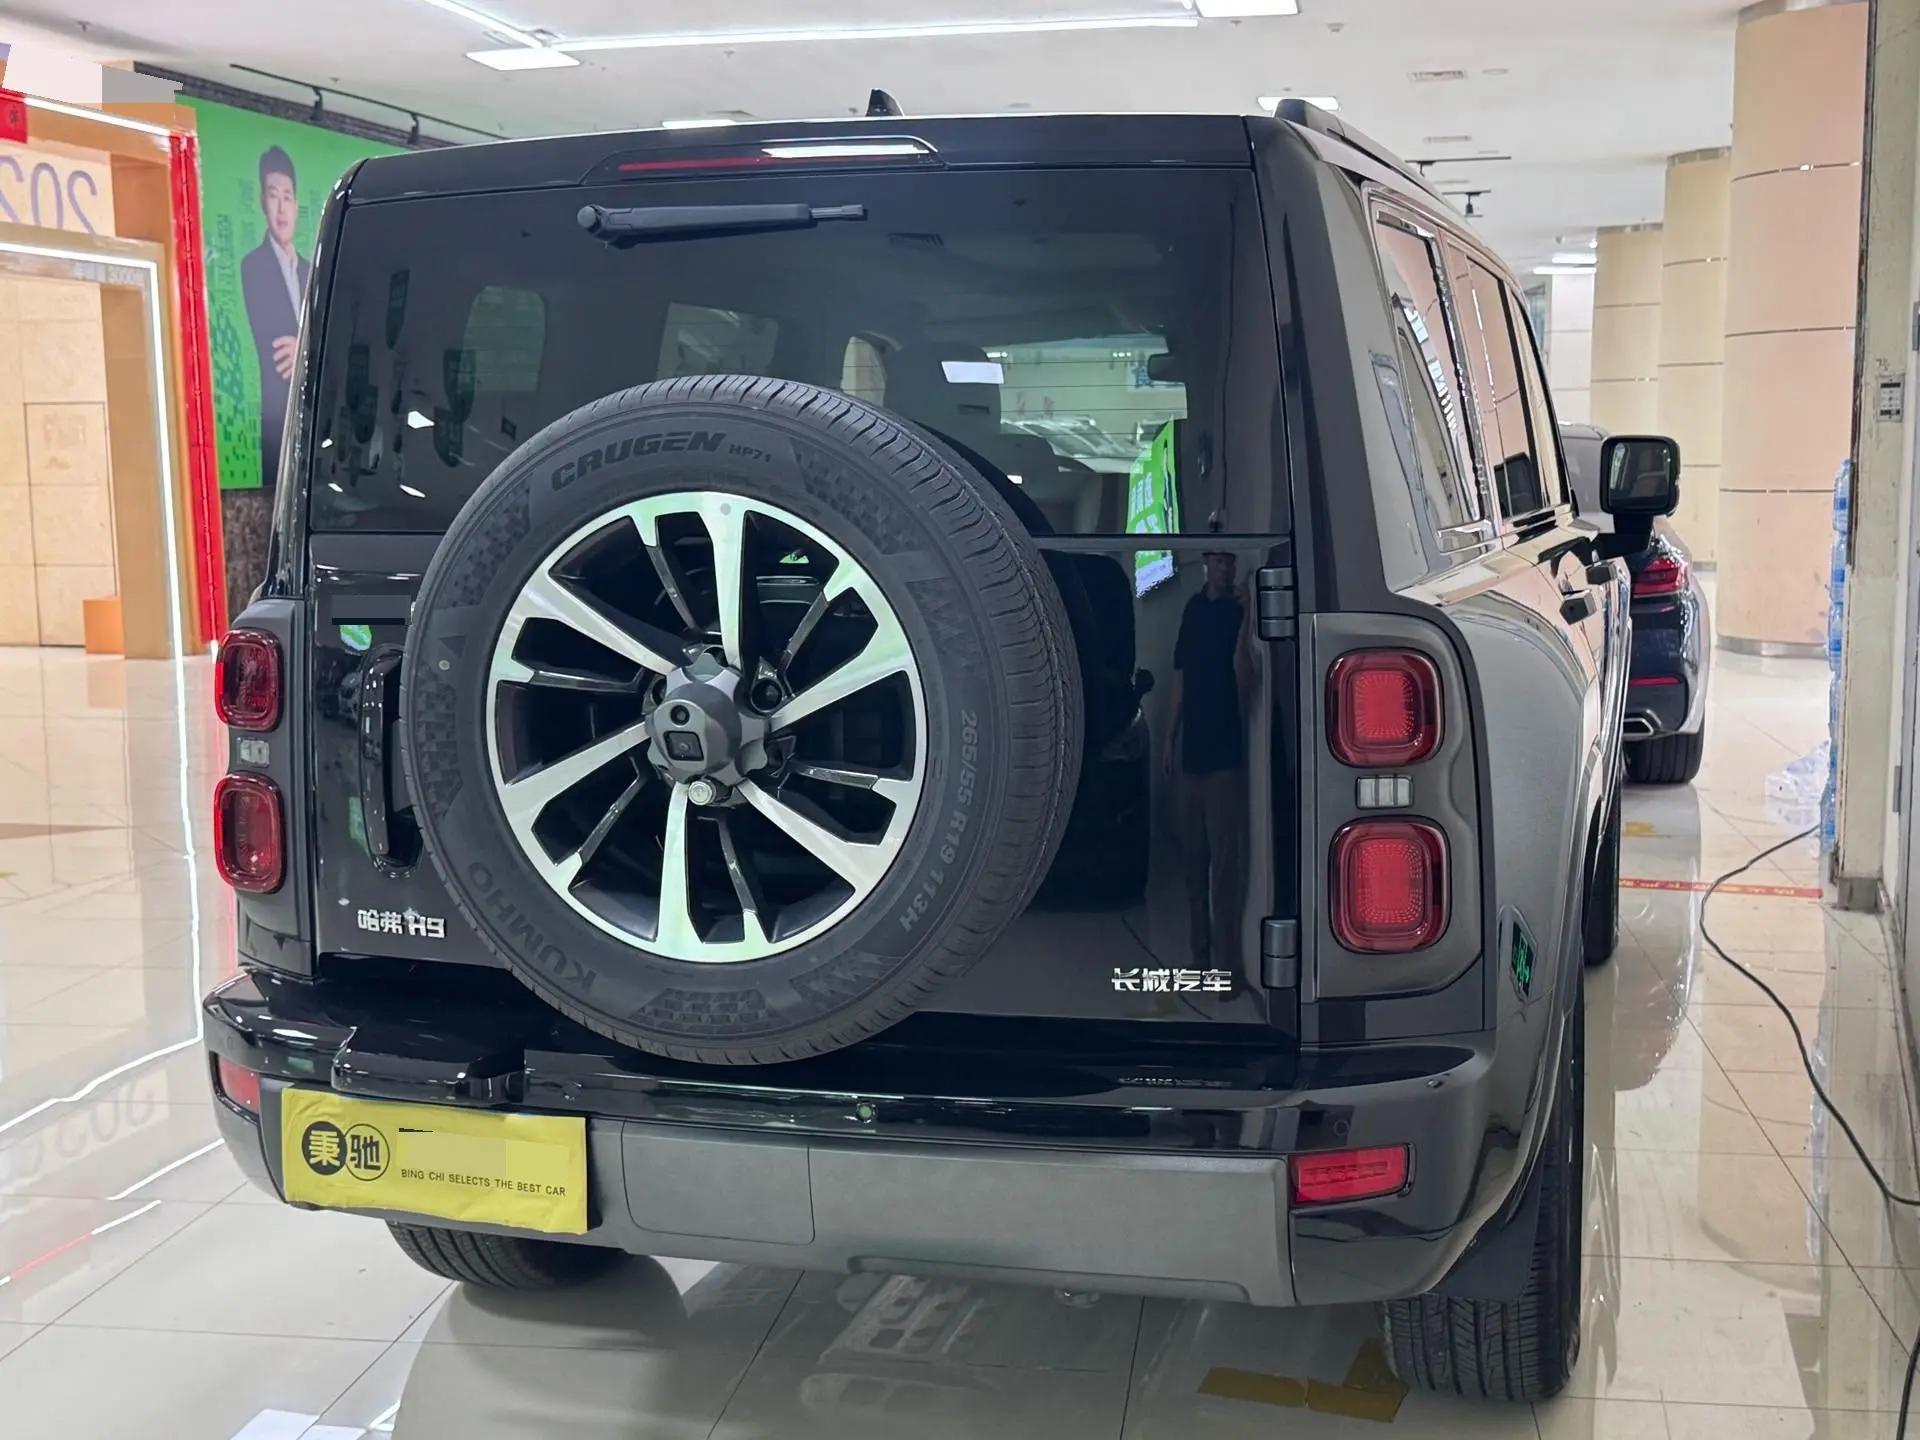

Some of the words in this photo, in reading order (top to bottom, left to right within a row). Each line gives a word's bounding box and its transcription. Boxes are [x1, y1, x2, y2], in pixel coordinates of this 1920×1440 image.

[551, 431, 726, 491] CRUGEN
[729, 444, 772, 463] HP71
[958, 709, 978, 807] 265/55
[940, 809, 969, 865] R19
[467, 862, 598, 993] KUMHO
[899, 869, 945, 932] 113H
[1111, 967, 1232, 992] 长城汽车
[401, 1168, 425, 1181] BING
[428, 1170, 445, 1182] CHI
[448, 1173, 491, 1188] SELECTS
[495, 1178, 513, 1190] THE
[517, 1181, 542, 1193] BEST
[545, 1185, 567, 1197] CAR
